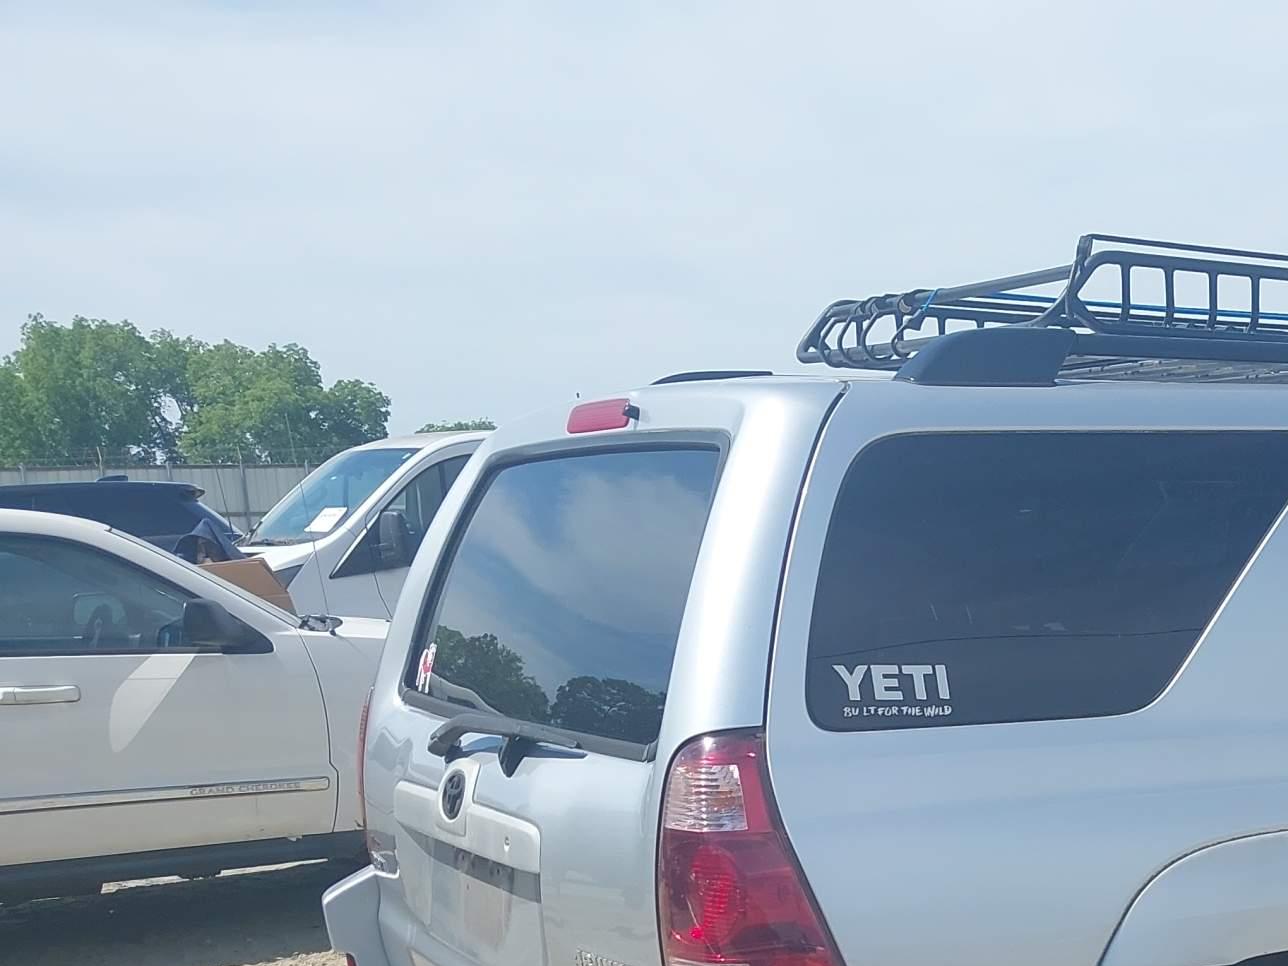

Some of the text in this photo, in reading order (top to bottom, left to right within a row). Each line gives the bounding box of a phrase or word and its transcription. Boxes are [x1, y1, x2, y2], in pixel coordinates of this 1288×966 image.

[831, 664, 951, 701] YETI
[878, 705, 899, 717] FOR
[901, 705, 923, 717] THE
[924, 704, 953, 718] WILD
[190, 785, 235, 796] GRAND
